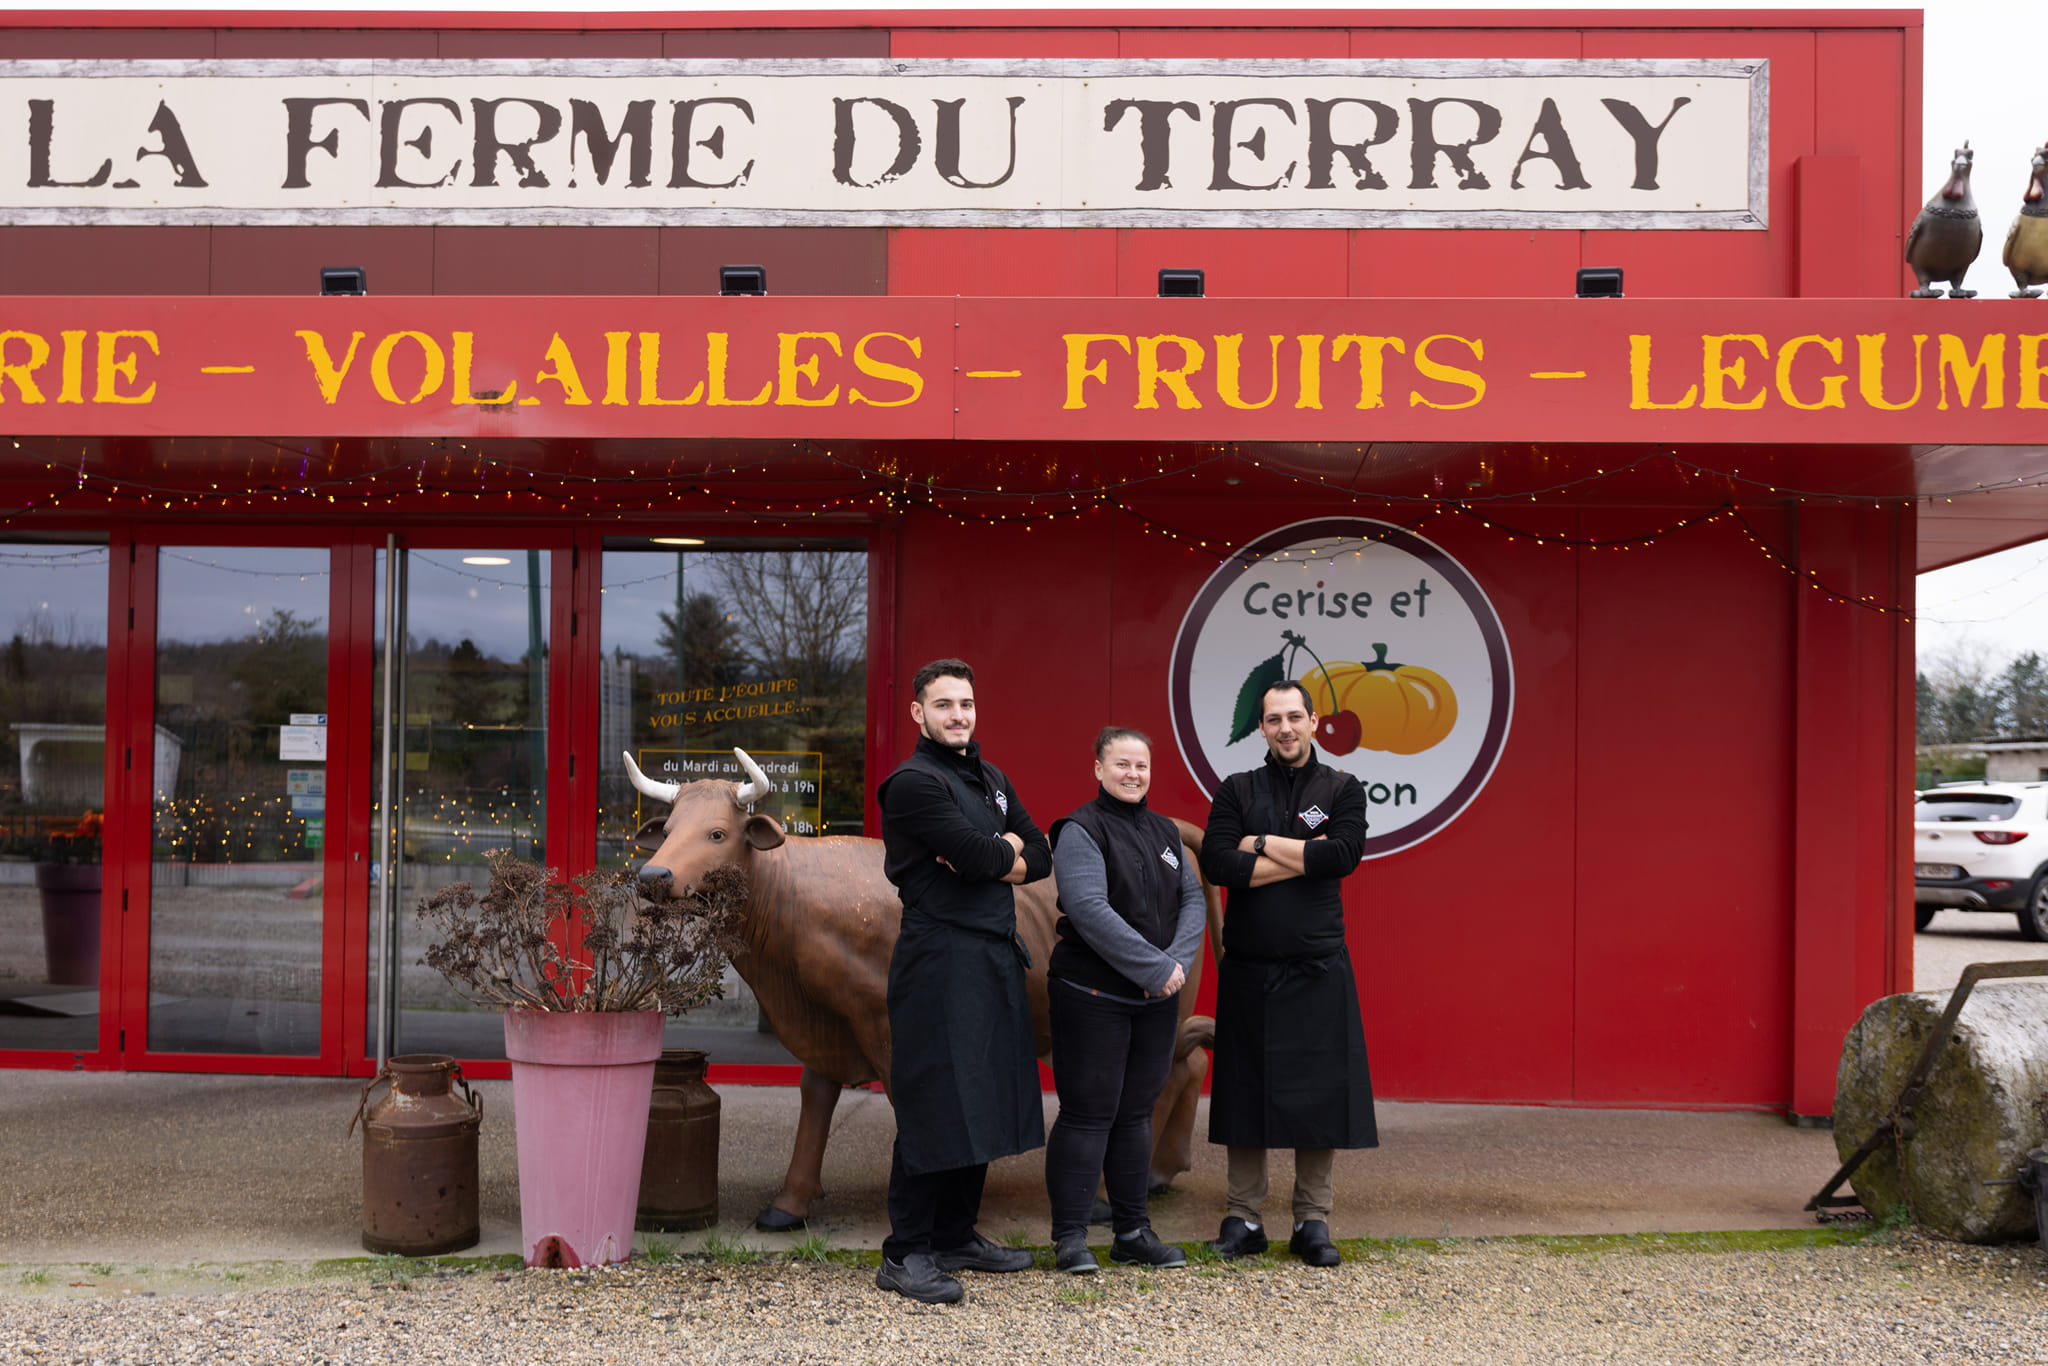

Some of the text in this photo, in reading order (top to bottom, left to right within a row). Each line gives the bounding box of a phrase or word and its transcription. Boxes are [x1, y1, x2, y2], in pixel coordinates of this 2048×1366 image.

[27, 96, 1691, 191] LA FERME DU TERRAY
[295, 330, 924, 407] VOLAILLES
[1062, 332, 1486, 410] FRUITS
[1243, 578, 1432, 619] Cerise et
[656, 678, 799, 706] TOUTE L'ÉQUIPE
[650, 711, 697, 728] VOUS
[663, 759, 679, 772] du
[683, 759, 719, 772] Mardi
[722, 763, 738, 773] au
[794, 780, 815, 793] 19h
[793, 821, 814, 833] 18h
